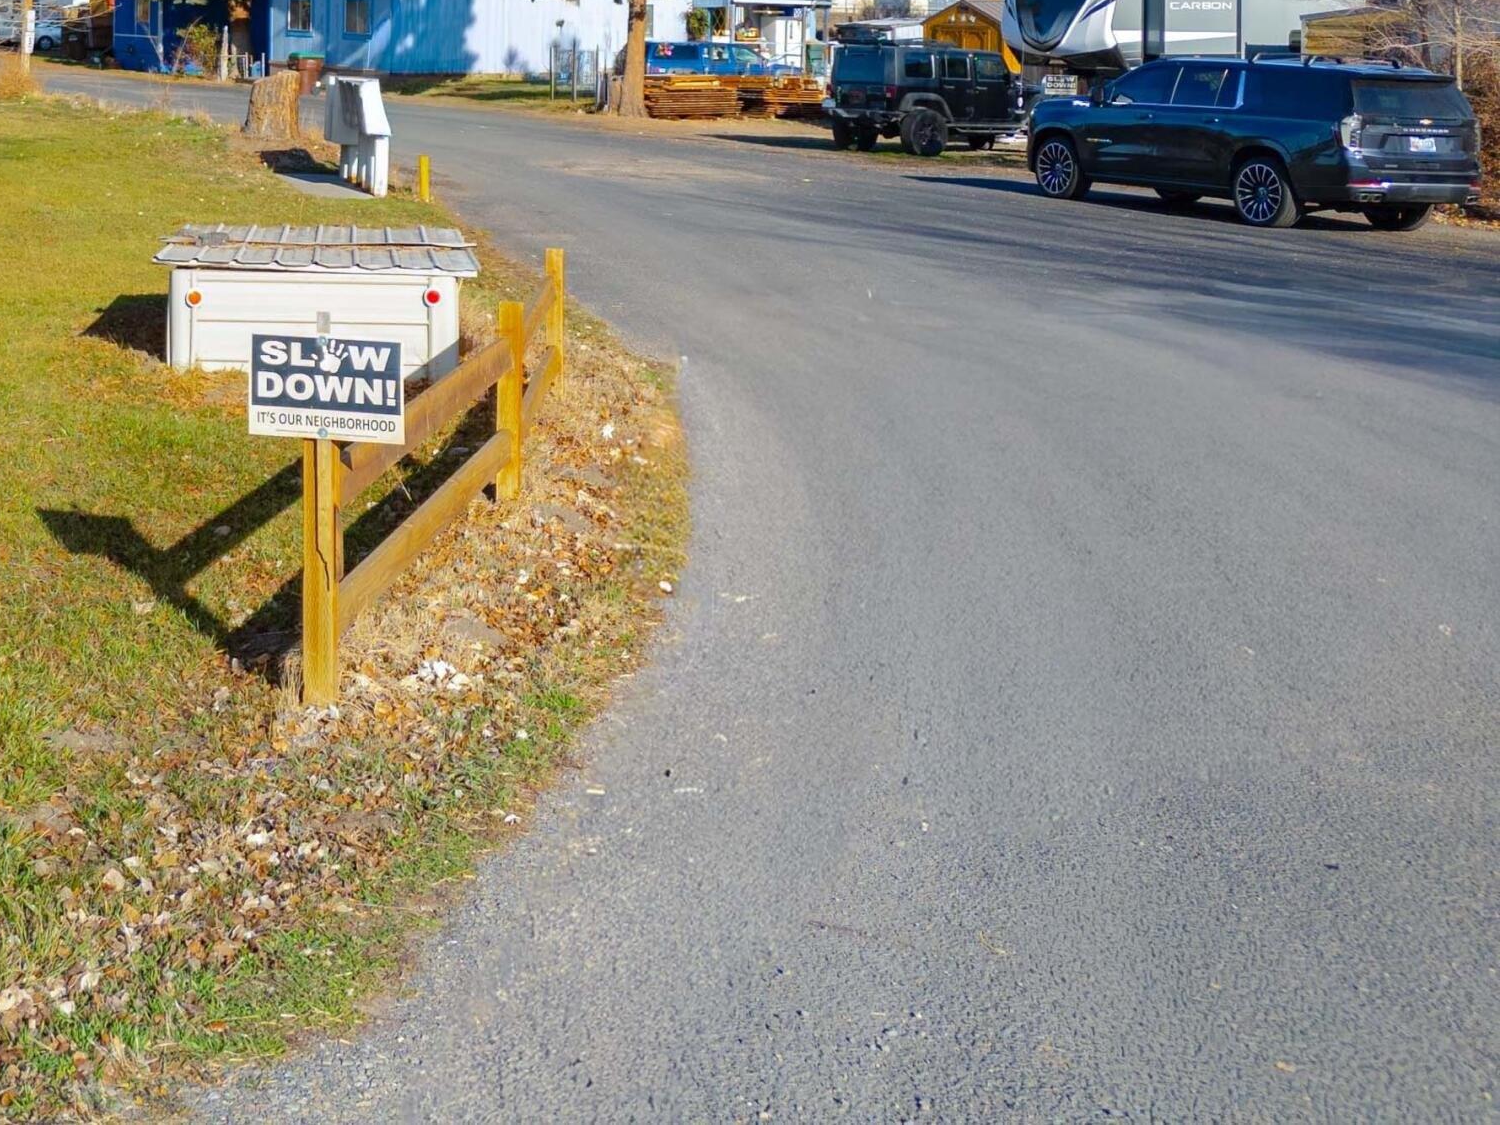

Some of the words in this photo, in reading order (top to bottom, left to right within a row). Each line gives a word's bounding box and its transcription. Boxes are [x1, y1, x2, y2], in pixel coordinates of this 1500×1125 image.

[1169, 1, 1233, 11] CARBON
[260, 339, 391, 374] SLW
[257, 371, 397, 407] DOWN!
[257, 411, 276, 424] IT'S
[278, 413, 303, 426] OUR
[305, 414, 397, 433] NEIGHBORHOOD
